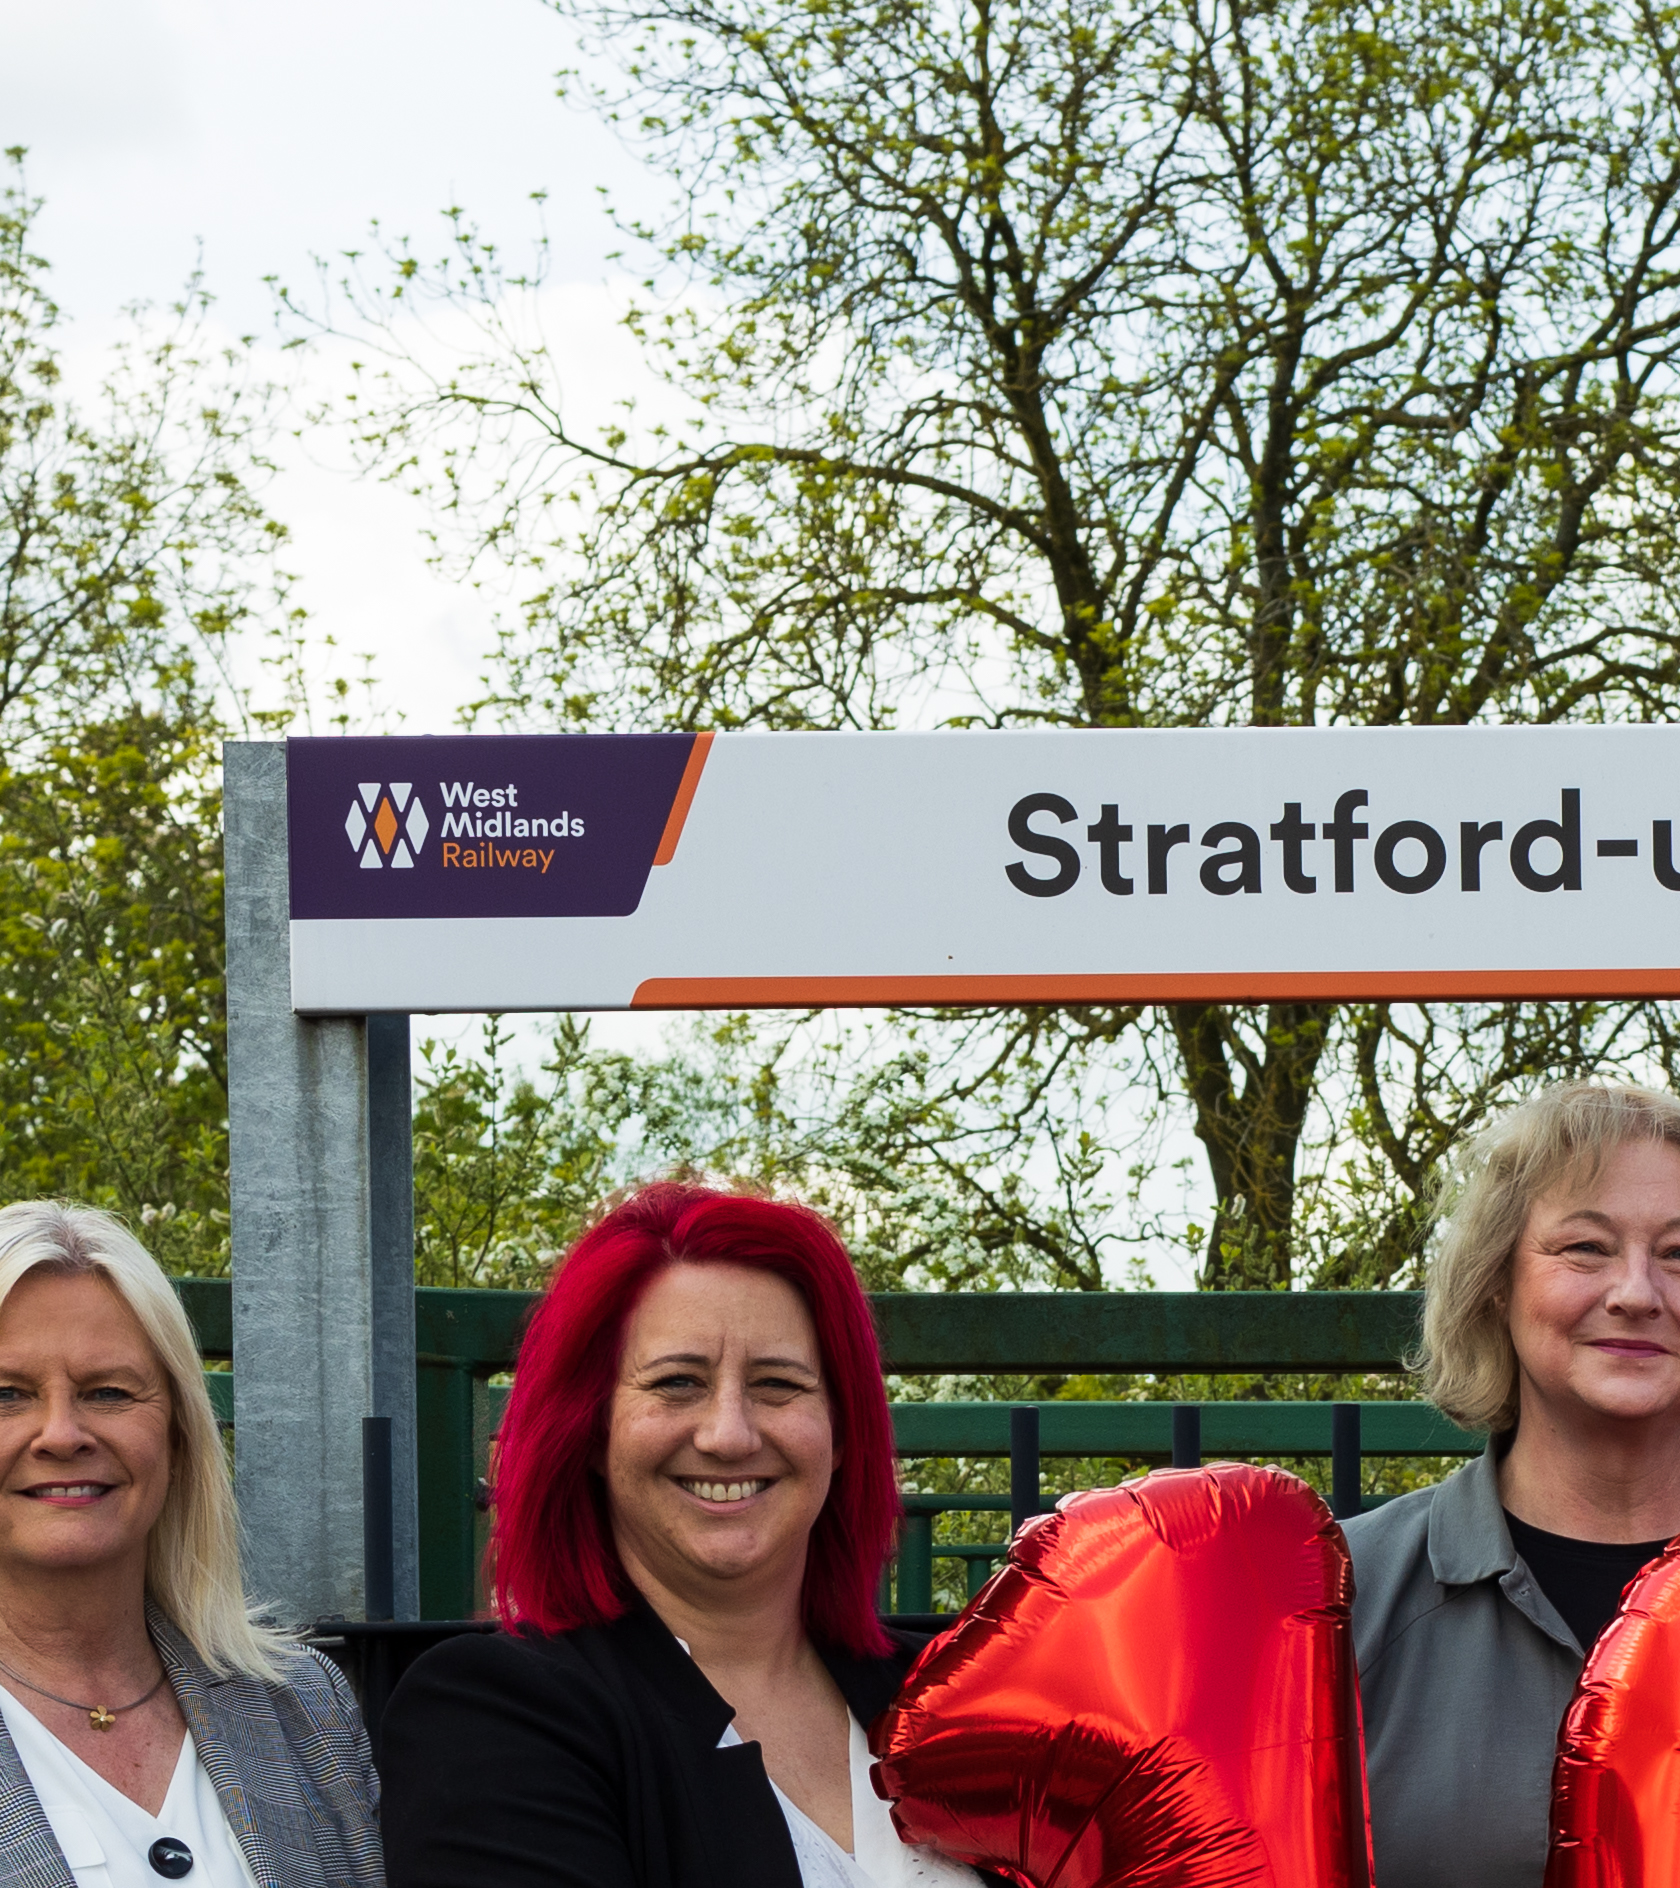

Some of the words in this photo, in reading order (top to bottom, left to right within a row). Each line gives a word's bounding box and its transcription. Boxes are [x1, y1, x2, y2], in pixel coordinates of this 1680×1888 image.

[439, 782, 518, 808] West
[440, 811, 585, 838] Midlands
[442, 842, 555, 874] Railway
